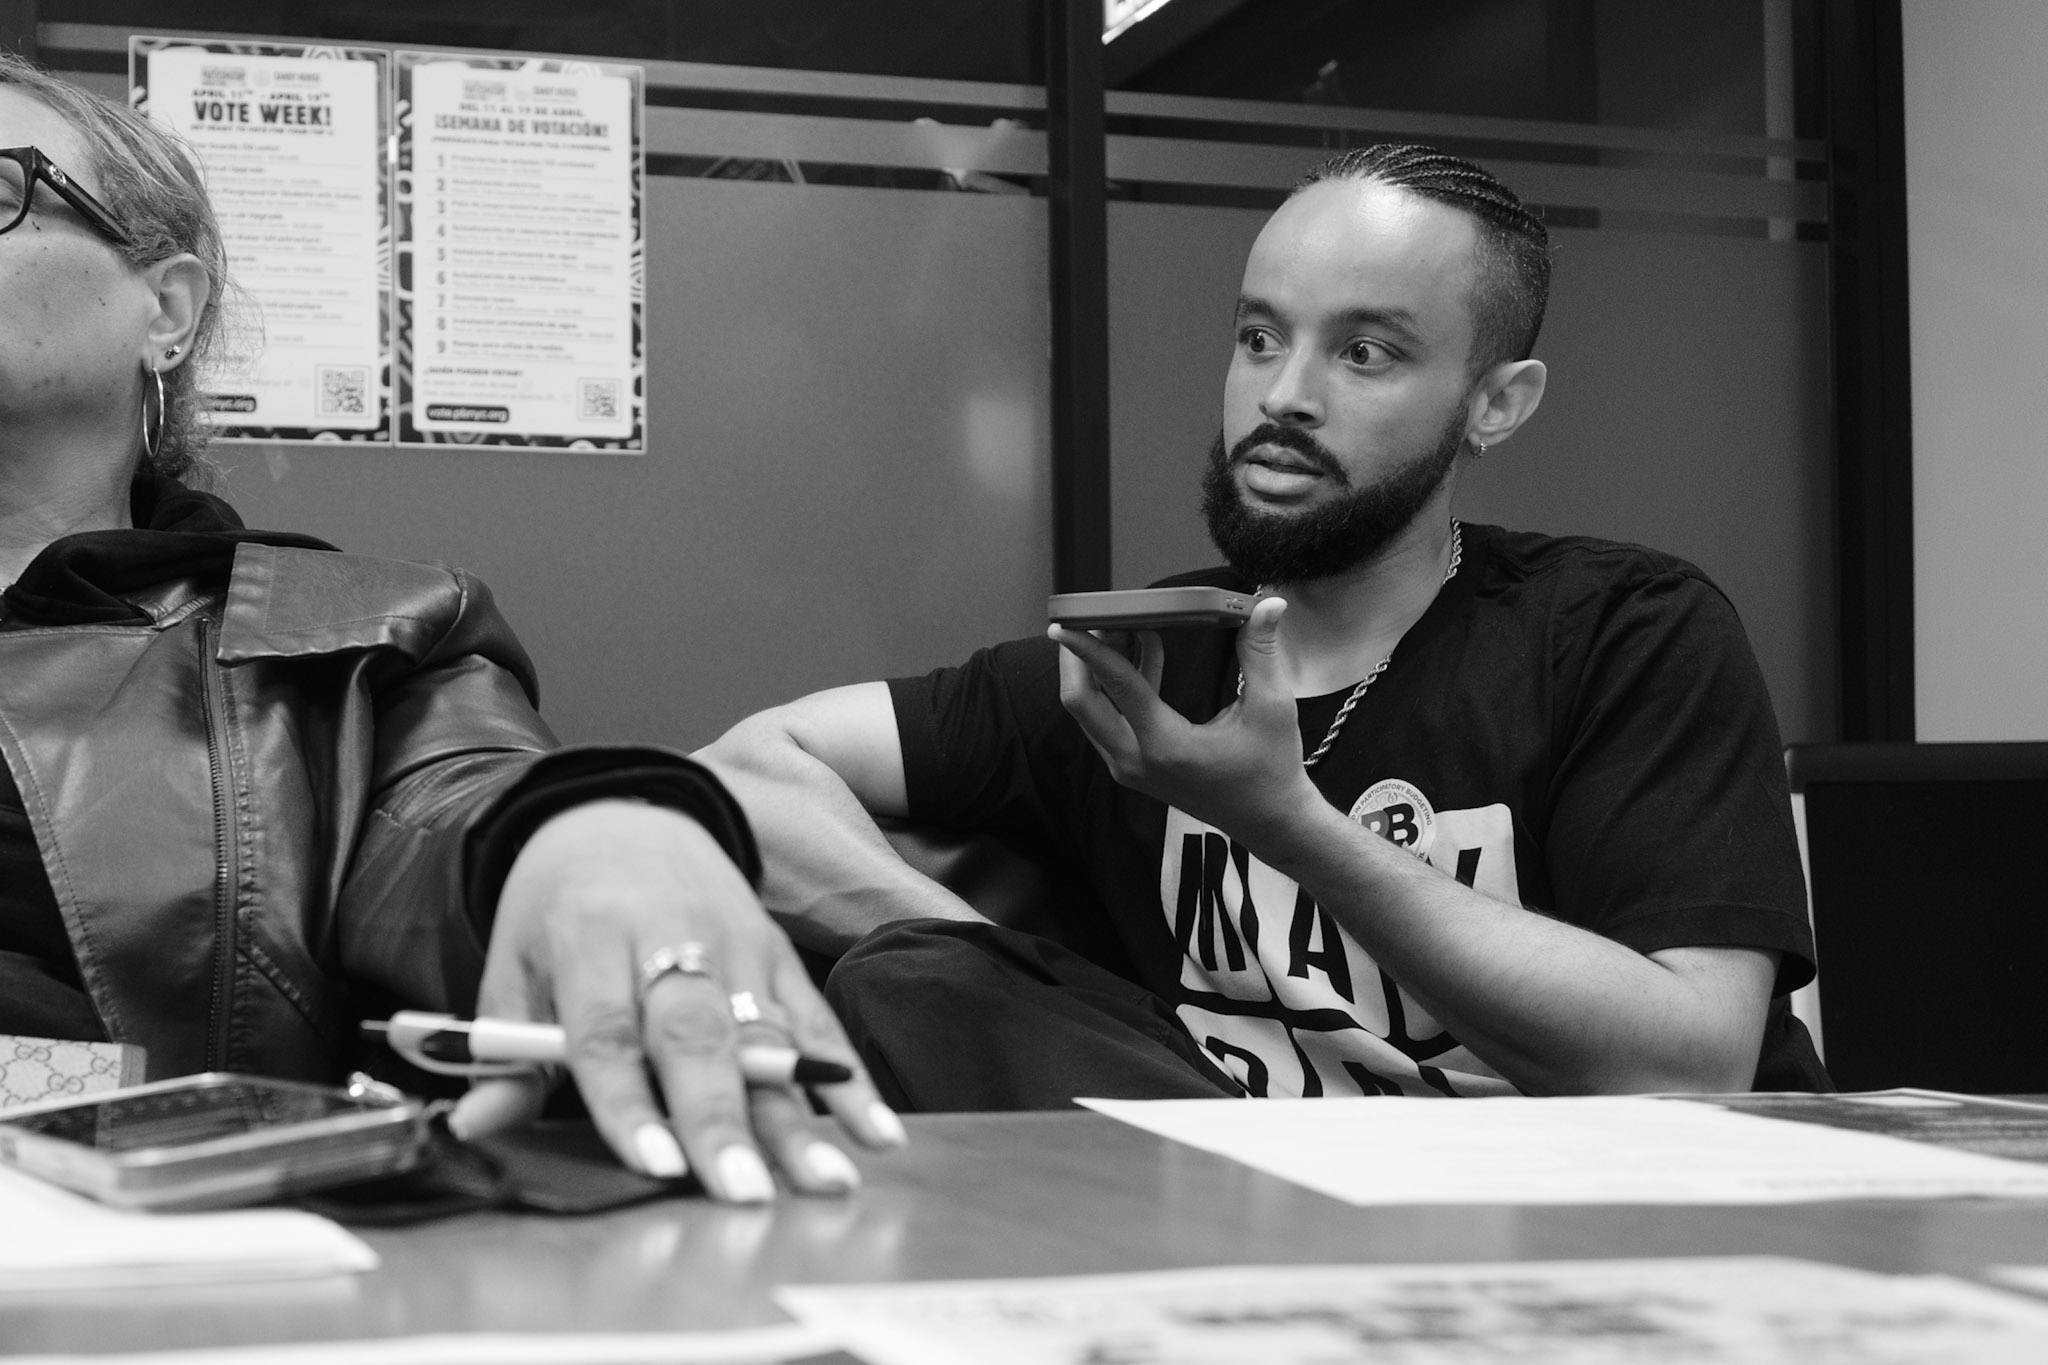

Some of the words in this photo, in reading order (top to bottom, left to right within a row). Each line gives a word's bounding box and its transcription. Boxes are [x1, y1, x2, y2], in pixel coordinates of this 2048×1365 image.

[194, 101, 249, 123] VOTE
[259, 104, 331, 126] WEEK!
[507, 118, 526, 134] DE
[437, 154, 444, 168] 1
[436, 177, 446, 191] 2
[436, 223, 446, 238] 4
[436, 293, 446, 307] 7
[1354, 806, 1361, 814] IN
[1361, 783, 1405, 806] PARTICIPATORY
[1405, 788, 1432, 826] BUDGETING
